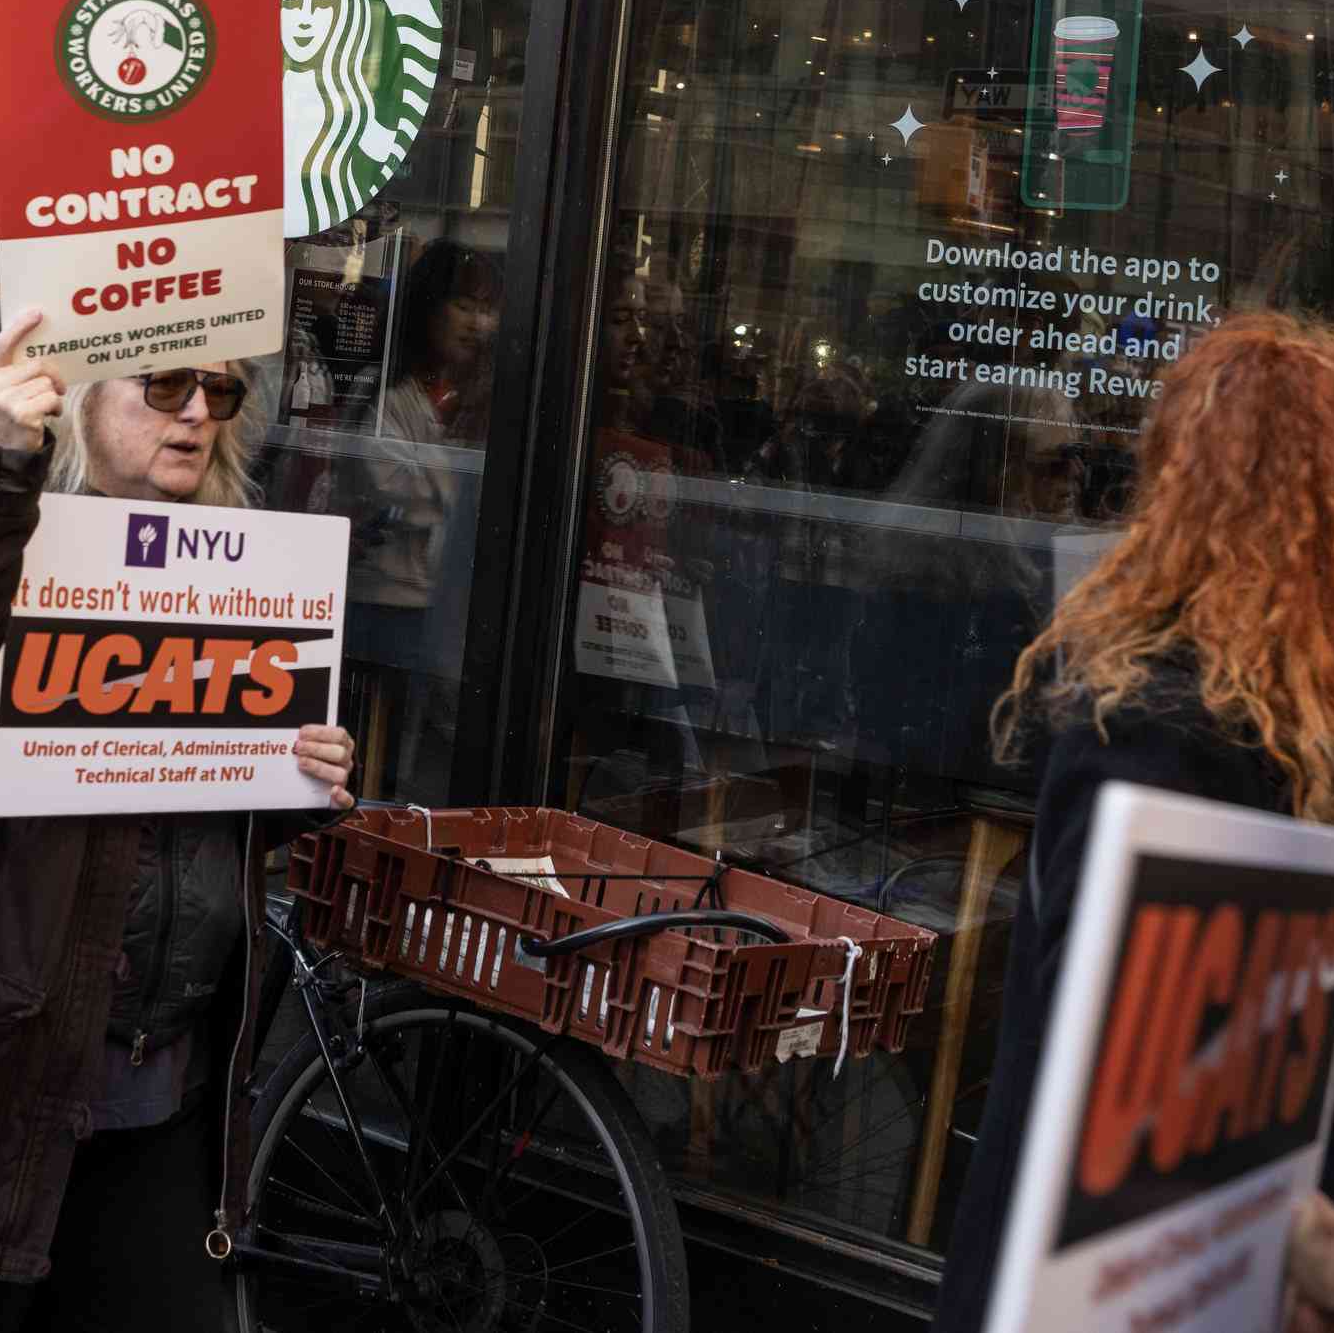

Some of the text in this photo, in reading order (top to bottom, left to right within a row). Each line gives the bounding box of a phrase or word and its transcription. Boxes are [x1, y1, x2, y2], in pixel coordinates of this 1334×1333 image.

[67, 36, 143, 114] WORKERS
[155, 30, 207, 107] UNITED
[110, 143, 175, 179] NO
[24, 175, 259, 228] CONTRACT
[116, 237, 177, 271] NO
[925, 238, 1221, 286] Download the app to
[71, 268, 223, 316] COFFEE
[917, 280, 1222, 327] customize your drink,
[26, 332, 123, 359] STARBUCKS
[127, 318, 206, 342] WORKERS
[209, 308, 266, 328] UNITED
[86, 334, 208, 365] ON ULP STRIKE!
[948, 318, 1181, 362] order ahead and
[903, 355, 1166, 400] start earning Rewa
[176, 527, 245, 562] NYU
[38, 578, 131, 613] doesn't
[139, 585, 200, 616] work
[209, 587, 295, 620] without
[302, 592, 334, 621] us!
[10, 631, 300, 716] UCATS
[22, 741, 76, 758] Union
[80, 740, 99, 757] of
[101, 739, 168, 759] Clerical,
[170, 739, 289, 757] Administrative
[74, 764, 256, 784] Technical Staff at NYU
